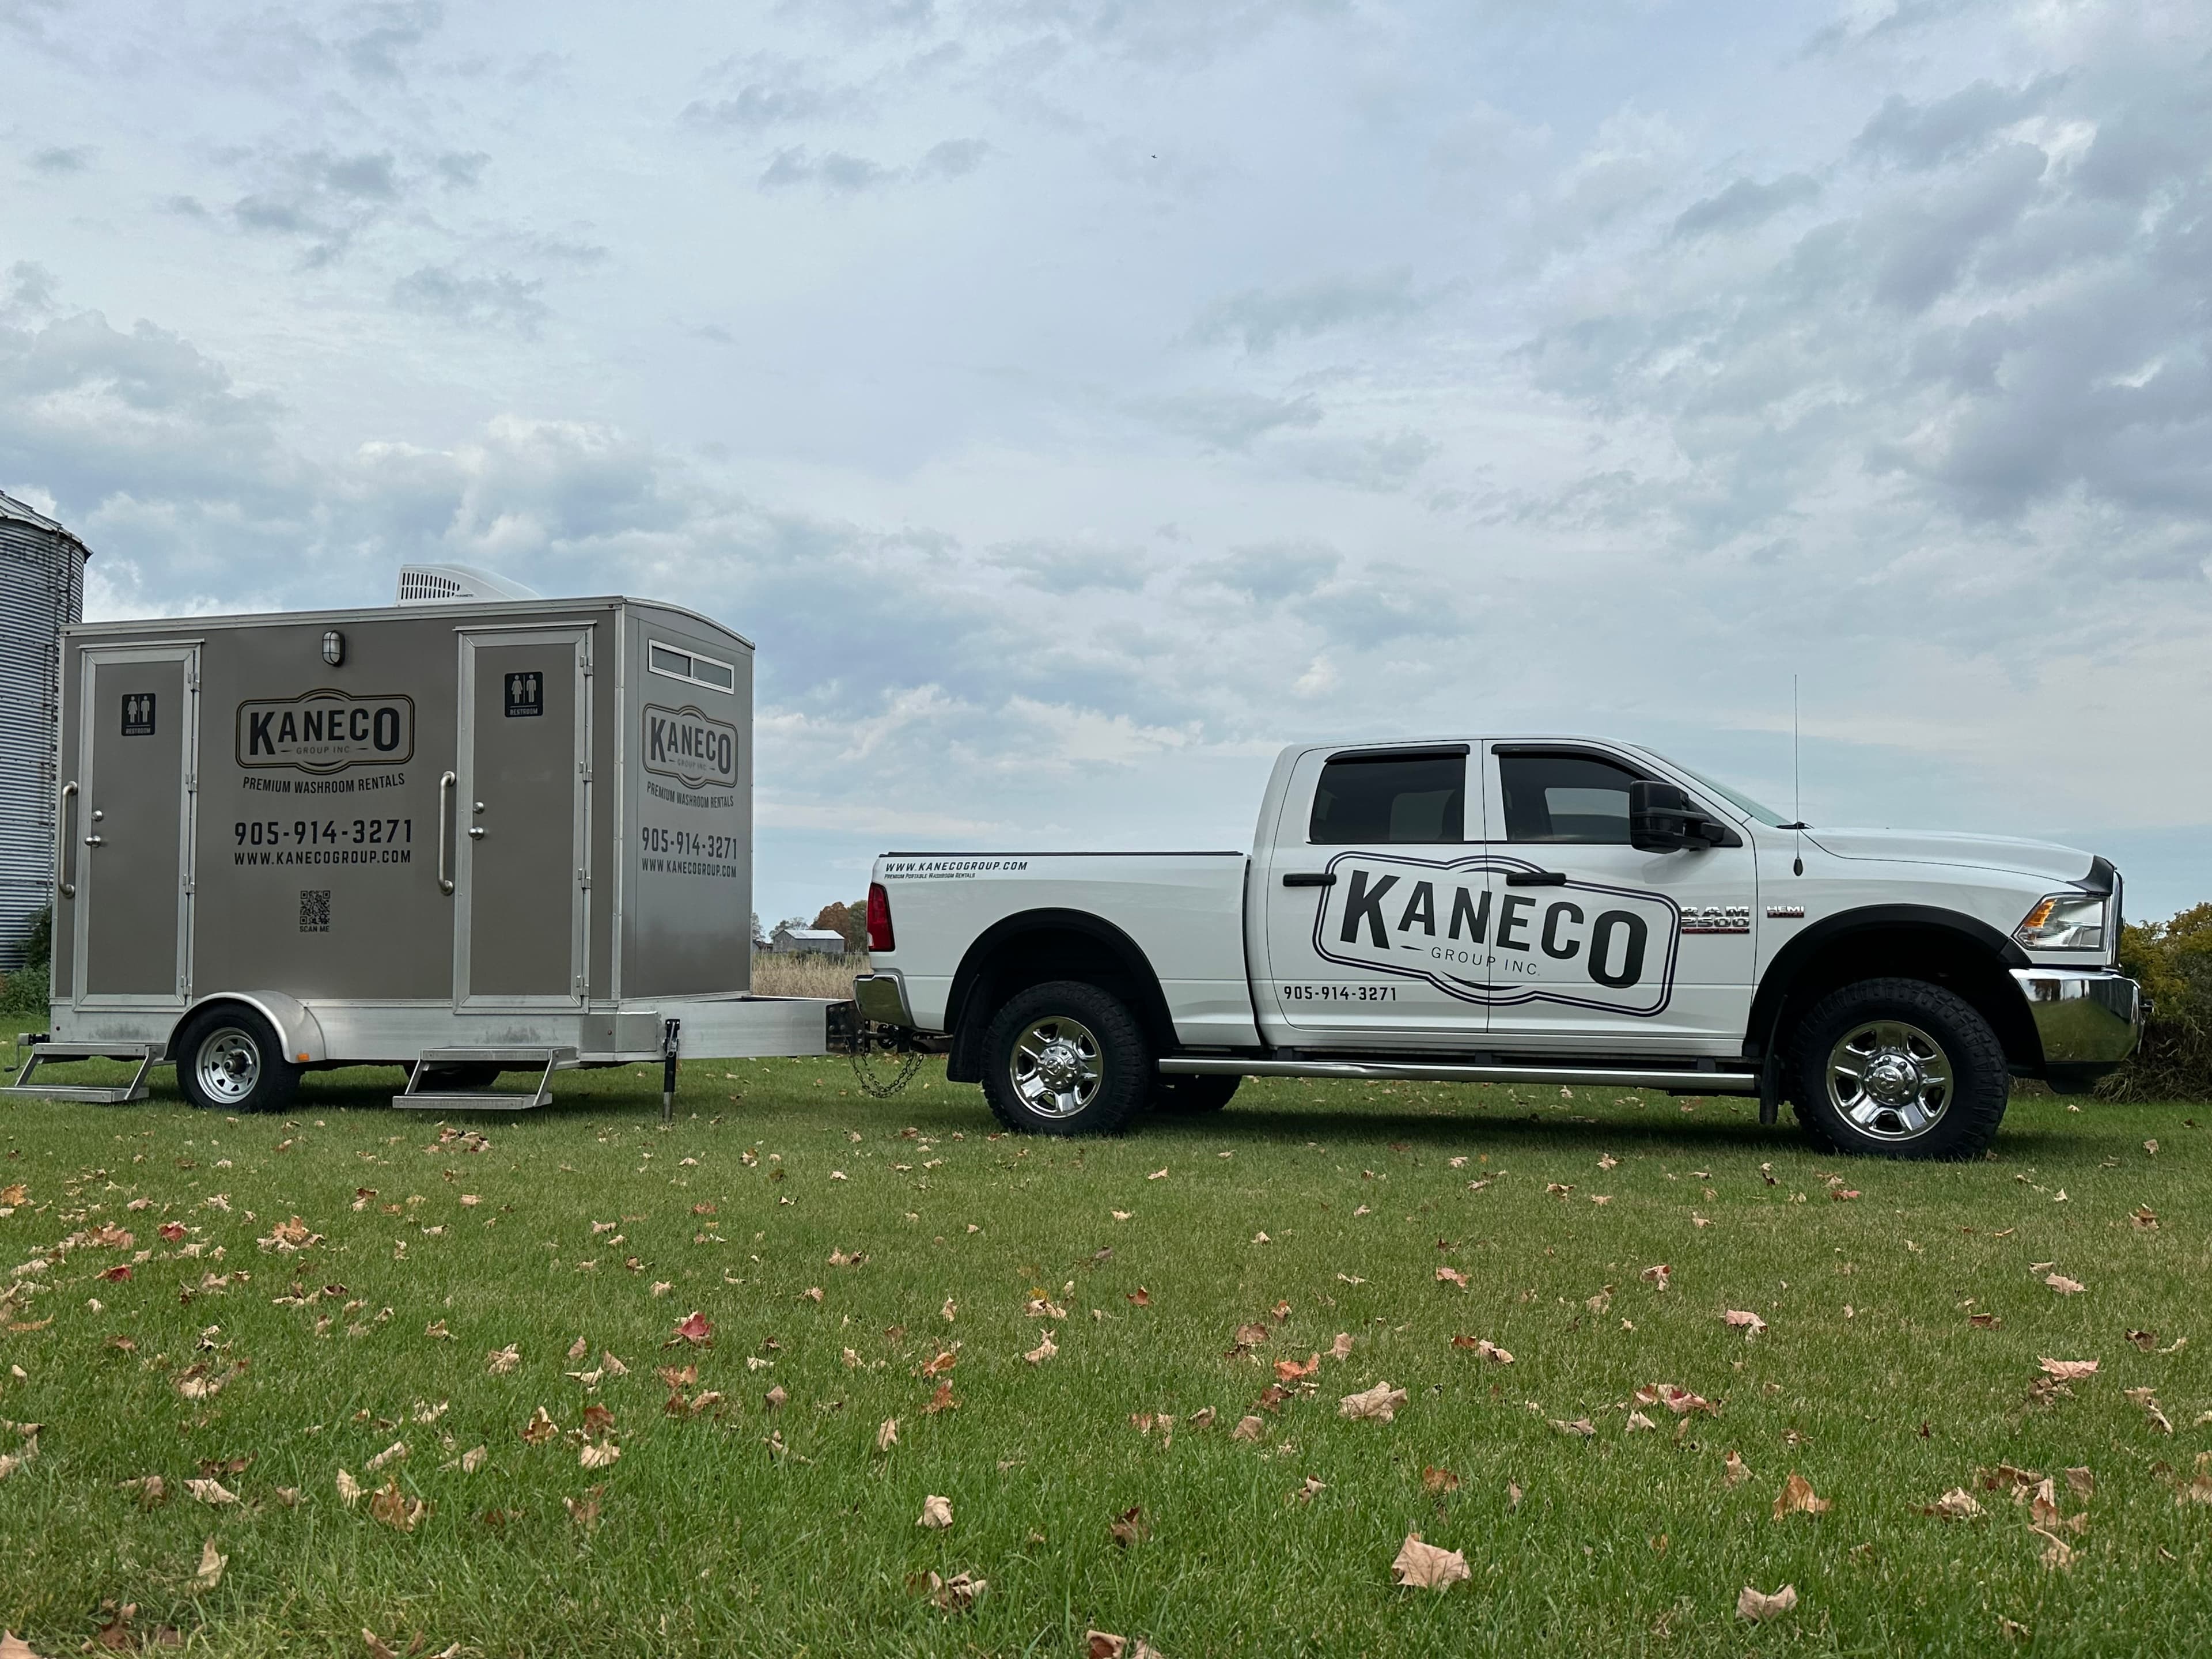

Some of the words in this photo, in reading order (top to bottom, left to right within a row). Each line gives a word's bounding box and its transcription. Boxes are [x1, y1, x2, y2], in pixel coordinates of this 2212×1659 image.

[249, 707, 400, 755] KANECO
[296, 747, 329, 755] GROUP
[650, 717, 731, 774] KANECO
[677, 759, 696, 769] GROUP
[243, 777, 290, 793] PREMIUM
[294, 780, 354, 794] WASHROOM
[358, 772, 405, 790] RENTALS
[647, 781, 675, 804] PREMIUM
[676, 791, 709, 808] WASHROOM
[710, 796, 734, 808] RENTALS
[235, 819, 411, 845] 905-914-3271
[642, 827, 737, 859] 905-914-3271
[234, 850, 411, 865] WWW.KANECOGROUP.COM
[885, 862, 1028, 872] WWW.KANECOGROUP.COM
[1681, 906, 1749, 916] RAM
[1340, 870, 1648, 989] KANECO
[1681, 917, 1749, 927] 2500
[1431, 947, 1495, 967] GROUP
[1284, 986, 1396, 1001] 905-914-3271
